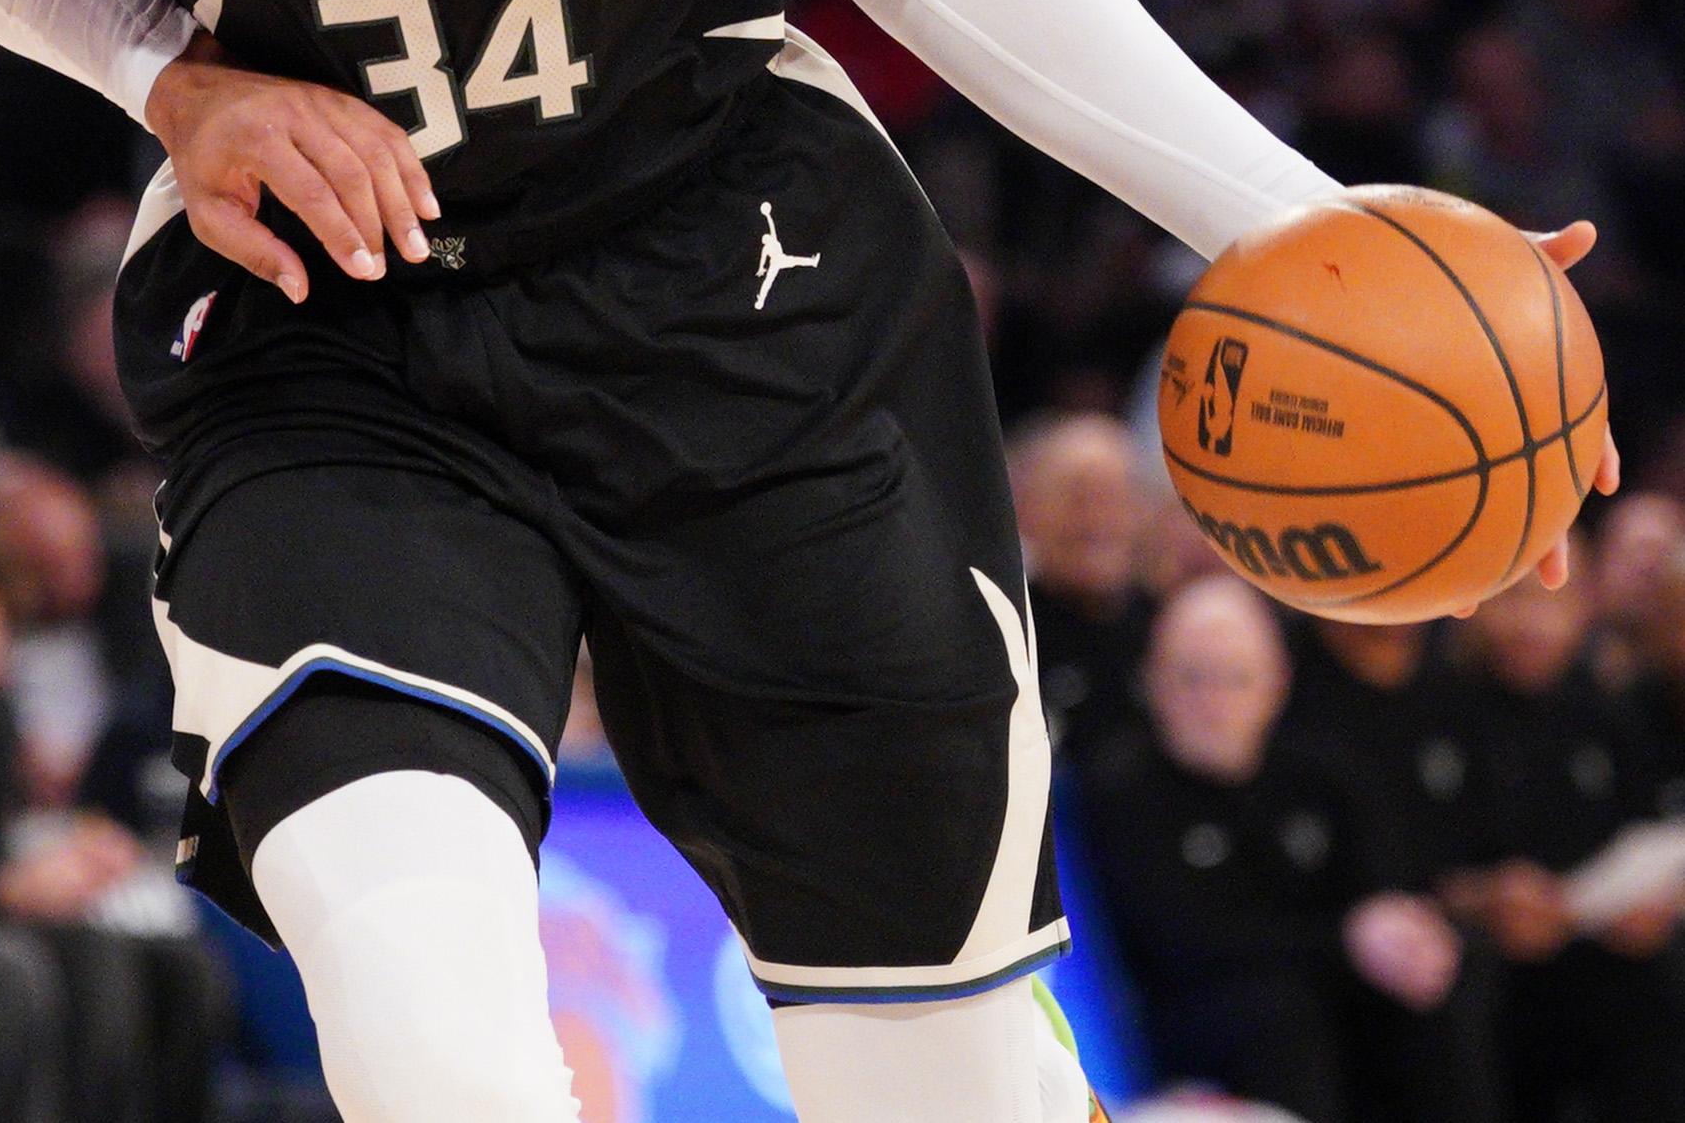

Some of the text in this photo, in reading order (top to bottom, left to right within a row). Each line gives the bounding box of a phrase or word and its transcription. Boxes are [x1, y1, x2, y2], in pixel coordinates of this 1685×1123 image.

[1251, 401, 1345, 437] OFFICIAL GAME BALL
